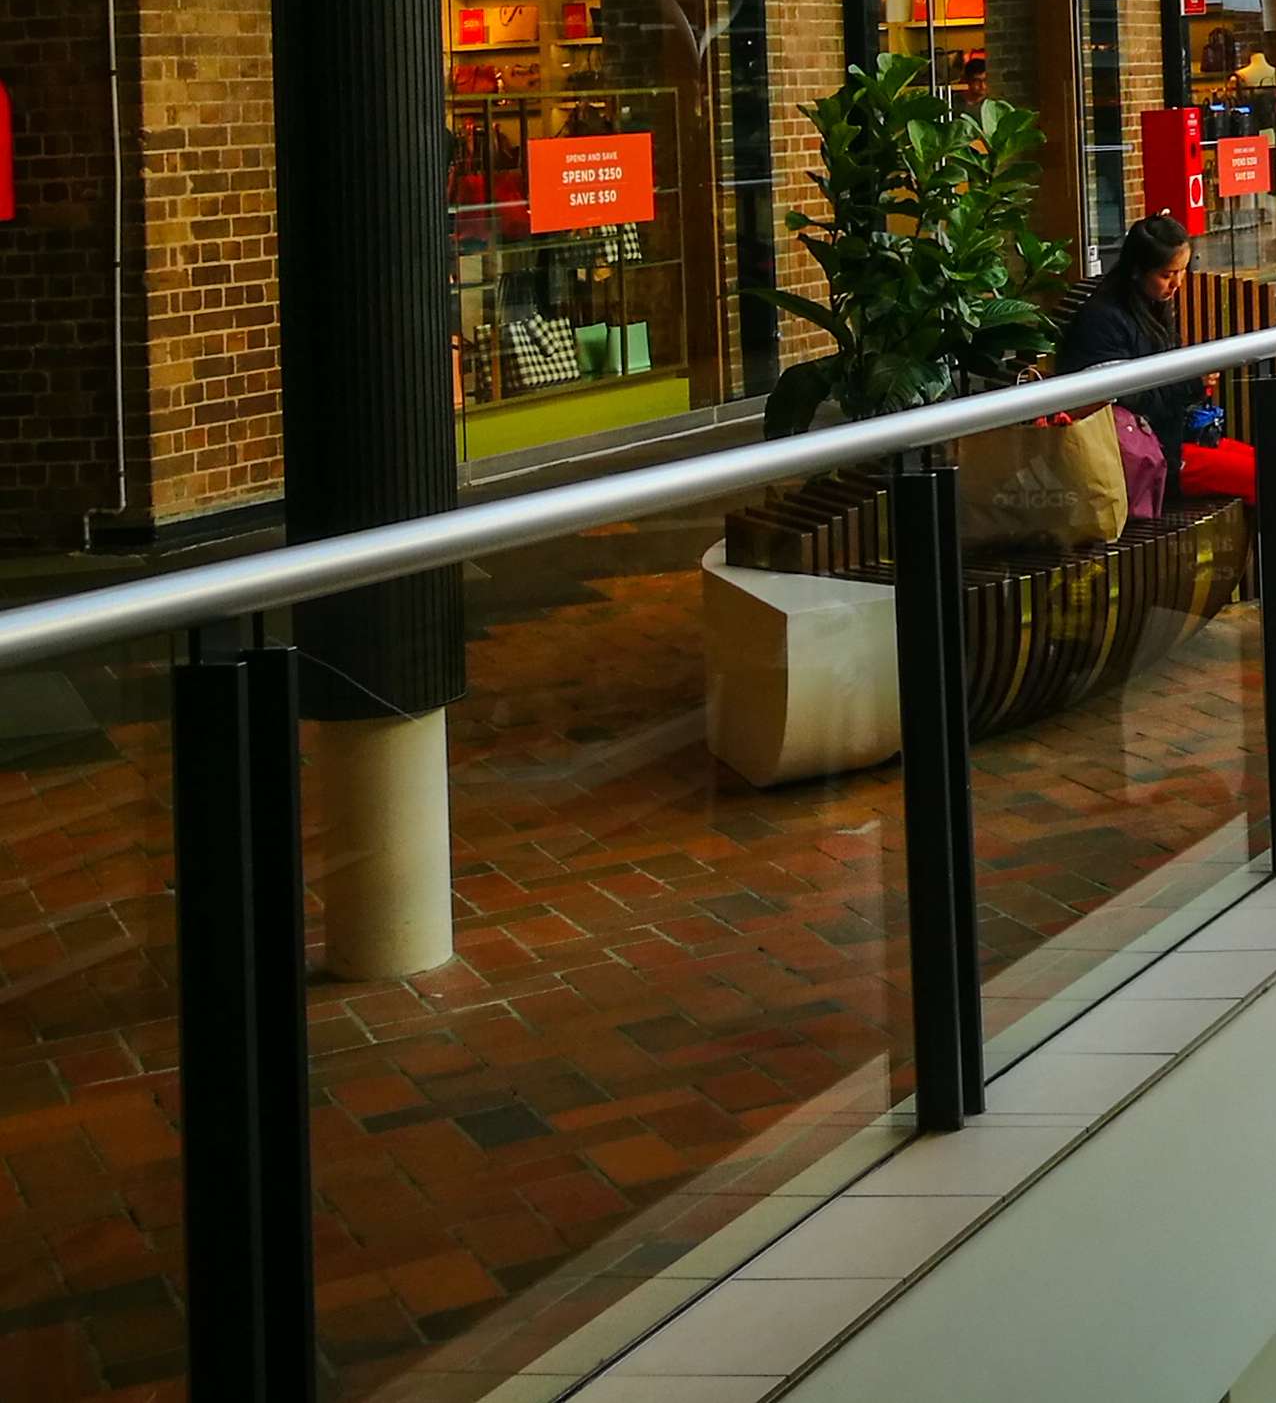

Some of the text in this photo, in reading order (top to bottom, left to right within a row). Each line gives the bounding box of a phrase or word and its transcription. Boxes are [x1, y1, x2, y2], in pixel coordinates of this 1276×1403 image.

[566, 151, 618, 164] SPEND AND SAVE
[562, 168, 622, 184] SPEND $250
[569, 190, 616, 206] SAVE $50
